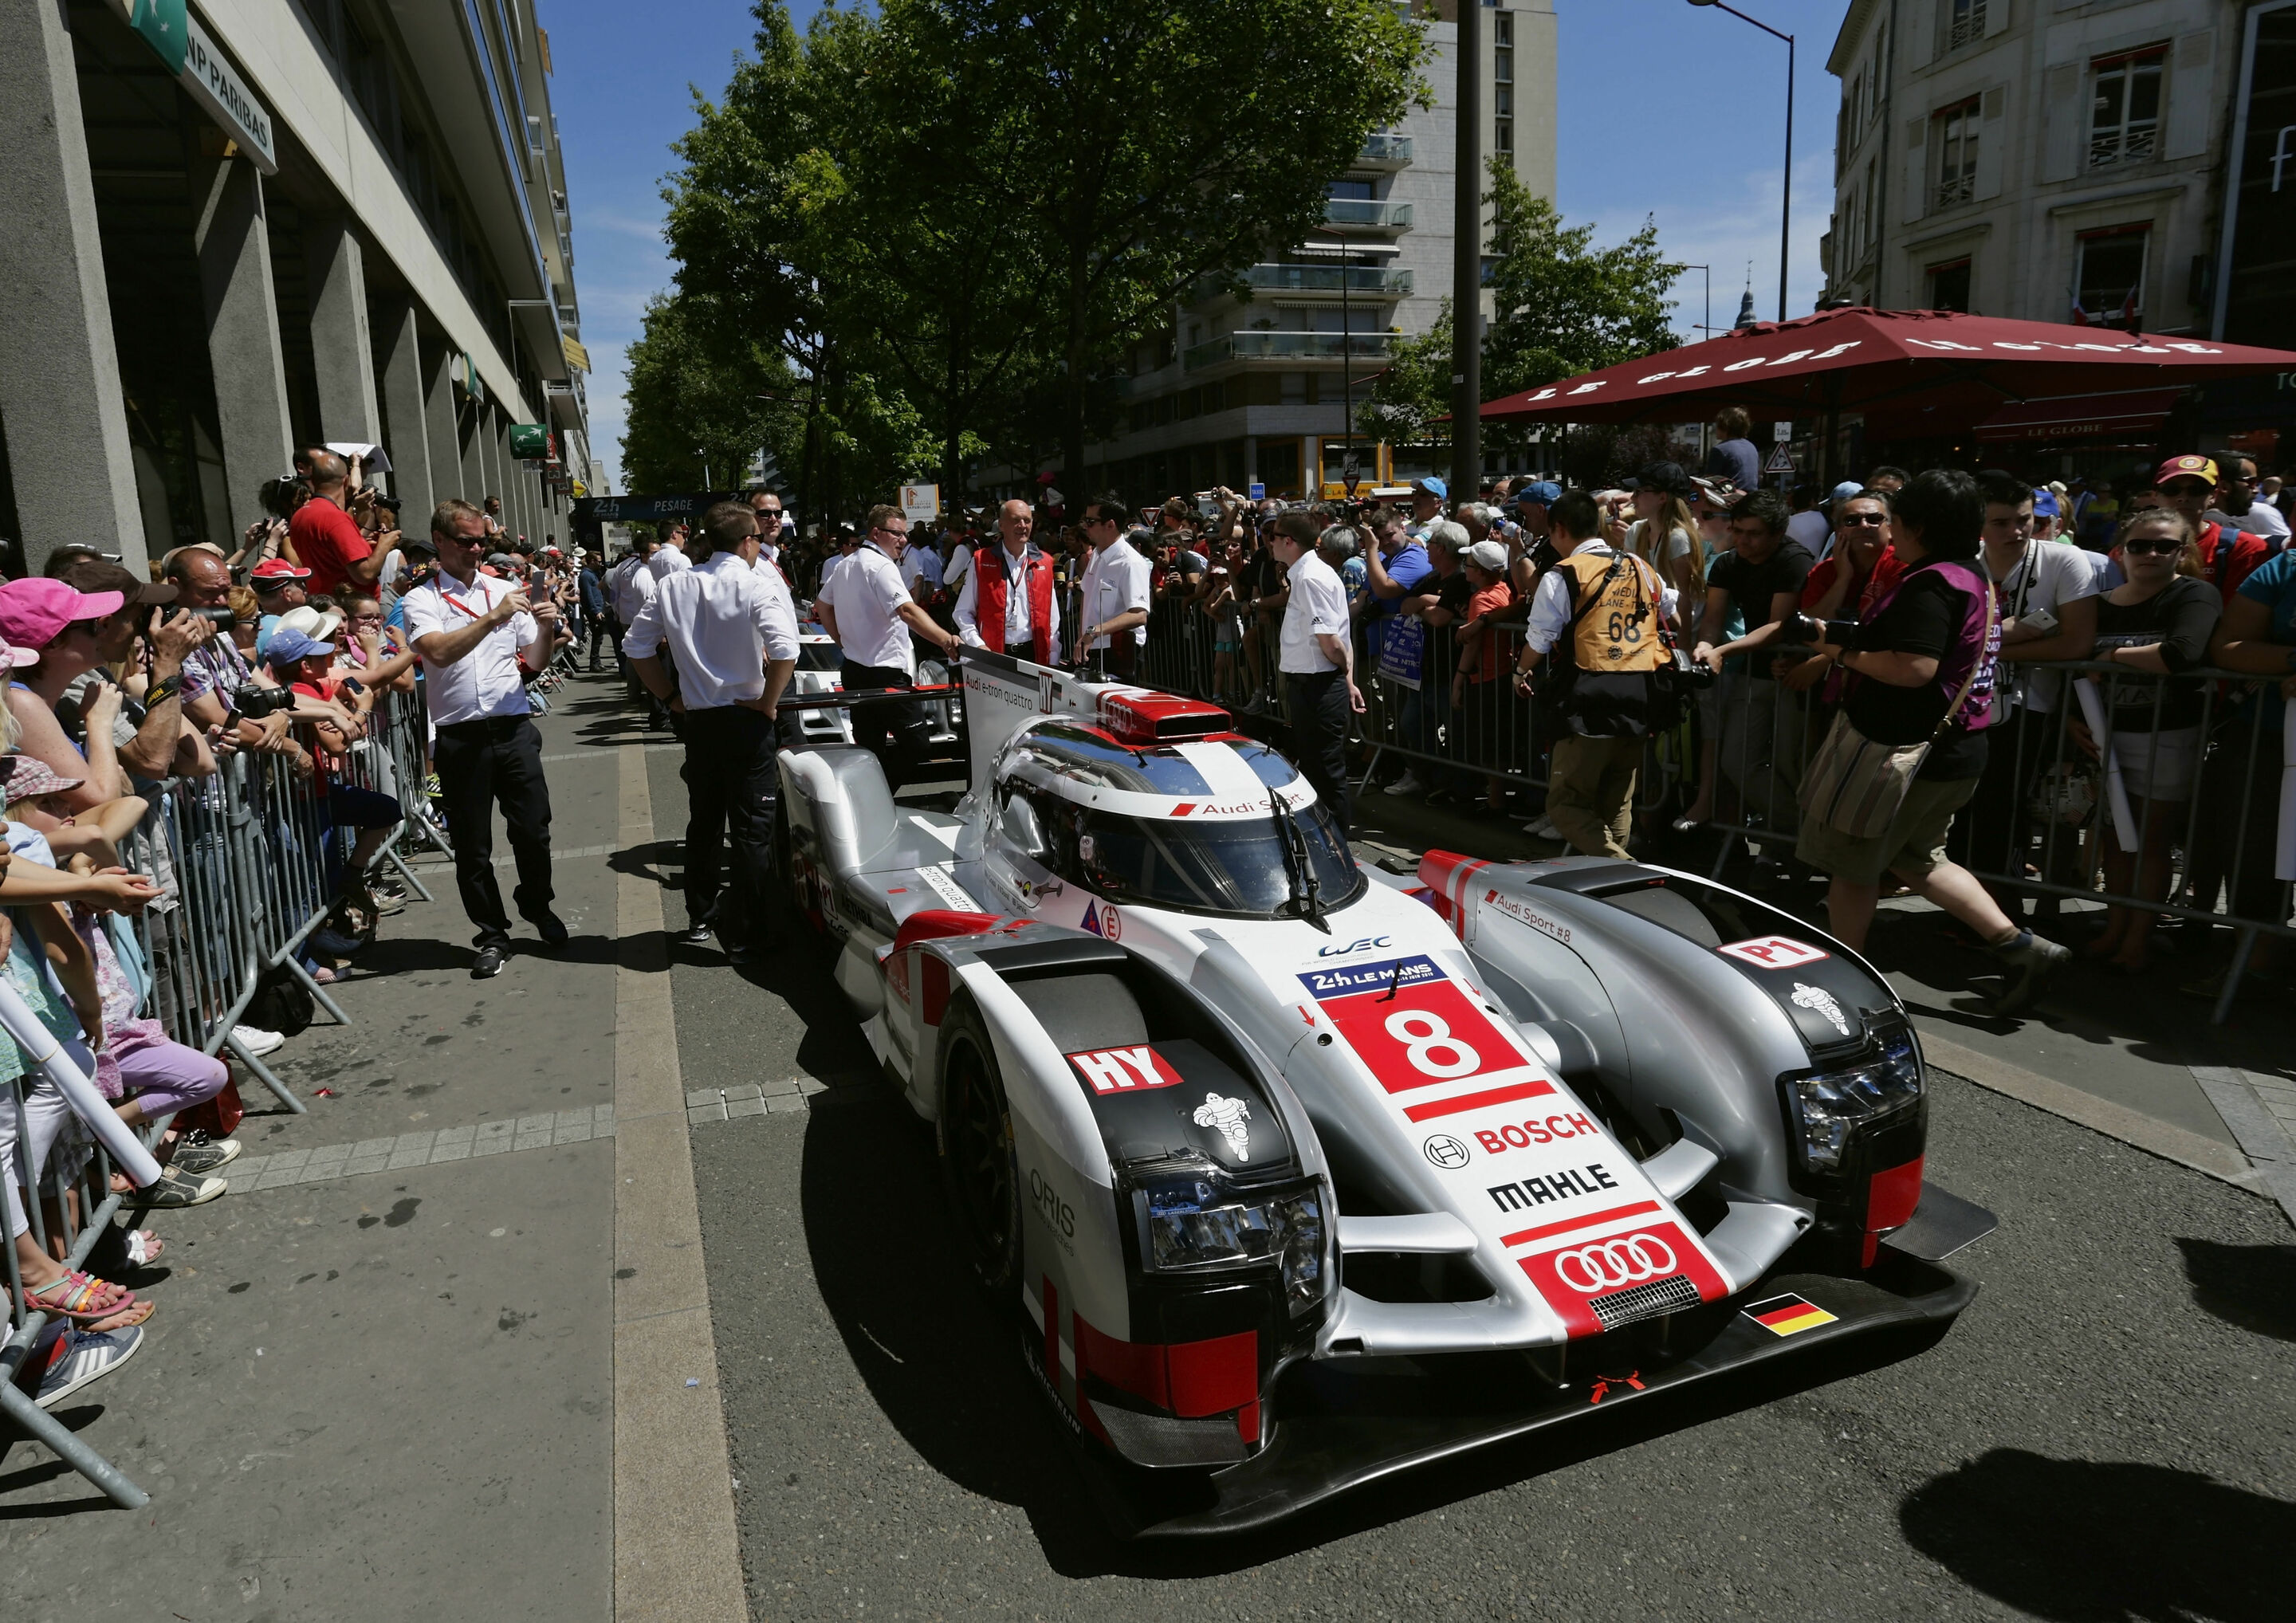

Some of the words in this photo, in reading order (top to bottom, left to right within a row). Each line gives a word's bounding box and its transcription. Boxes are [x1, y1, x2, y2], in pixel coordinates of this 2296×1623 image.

[210, 60, 268, 148] PARIBAS
[1905, 337, 1983, 351] LE
[1992, 340, 2223, 354] GLOBE
[1527, 380, 1607, 401] LE
[1637, 340, 1862, 384] GLOBE
[2027, 427, 2046, 437] LE
[2049, 423, 2103, 435] GLOBE
[654, 499, 693, 513] PESAGE
[1608, 611, 1641, 643] 68
[965, 674, 981, 692] Audi
[982, 682, 1003, 699] e-tron
[1004, 690, 1033, 711] quattro
[1039, 674, 1052, 713] HY
[1202, 802, 1255, 815] Audi
[1496, 894, 1521, 915] Audi
[1523, 907, 1555, 933] Sport
[1556, 926, 1571, 942] #8
[1319, 935, 1392, 957] WEC
[1741, 940, 1809, 964] P1
[1311, 972, 1353, 990] 24h
[1353, 973, 1378, 984] LE
[1378, 964, 1433, 980] MANS
[1384, 1009, 1481, 1079] 8
[1071, 1045, 1166, 1091] HY
[1475, 1112, 1598, 1154] BOSCH
[1030, 1168, 1075, 1238] ORIS
[1488, 1163, 1618, 1213] MAHLE
[1036, 1363, 1081, 1435] MICHELIN
